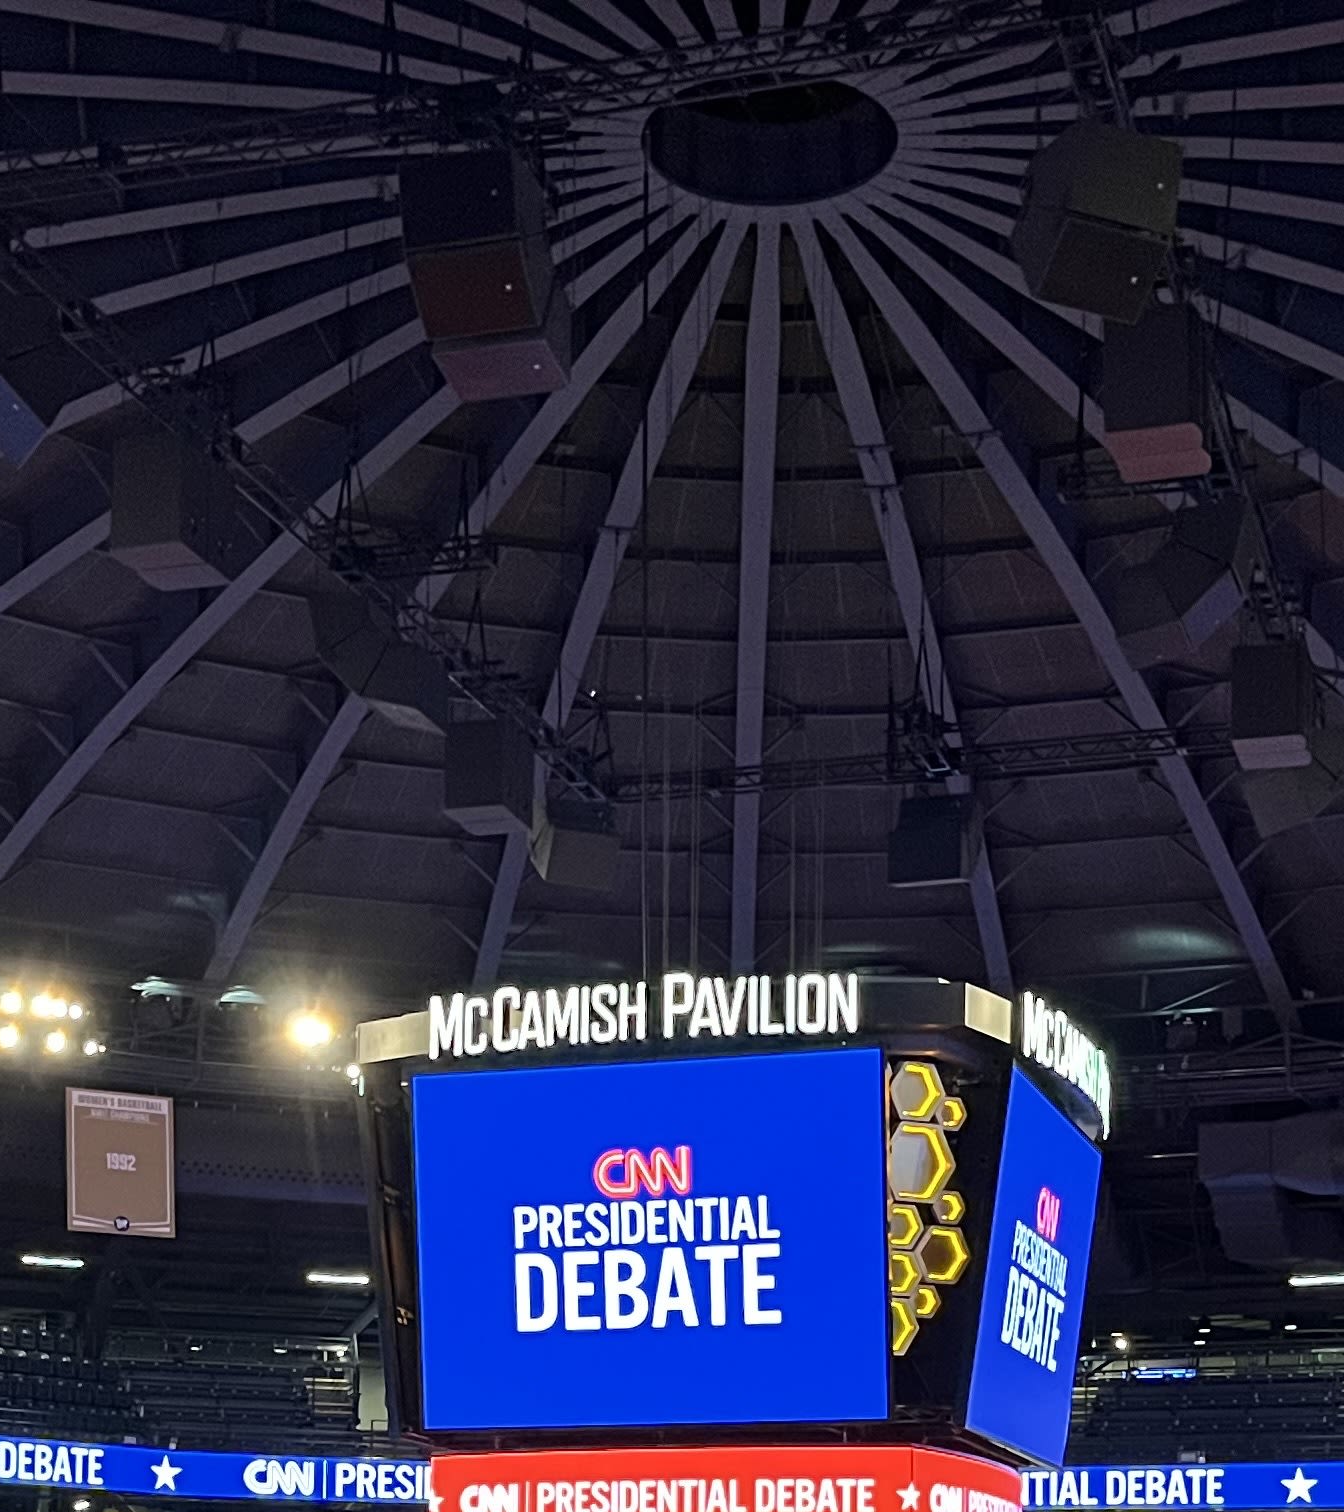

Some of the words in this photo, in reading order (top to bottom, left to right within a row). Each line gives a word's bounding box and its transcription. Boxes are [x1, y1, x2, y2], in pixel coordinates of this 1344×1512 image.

[663, 971, 858, 1039] PAVILION
[106, 1152, 136, 1172] 1992
[594, 1146, 691, 1199] CNN
[514, 1195, 781, 1249] PRESIDENTIAL
[1036, 1187, 1060, 1242] CNN
[1012, 1219, 1068, 1298] PRESIDENTIAL
[515, 1243, 782, 1333] DEBATE
[1001, 1265, 1065, 1373] DEBATE
[243, 1458, 315, 1496] CNN
[1021, 1470, 1098, 1506] TIAL
[1106, 1468, 1225, 1505] DEBATE
